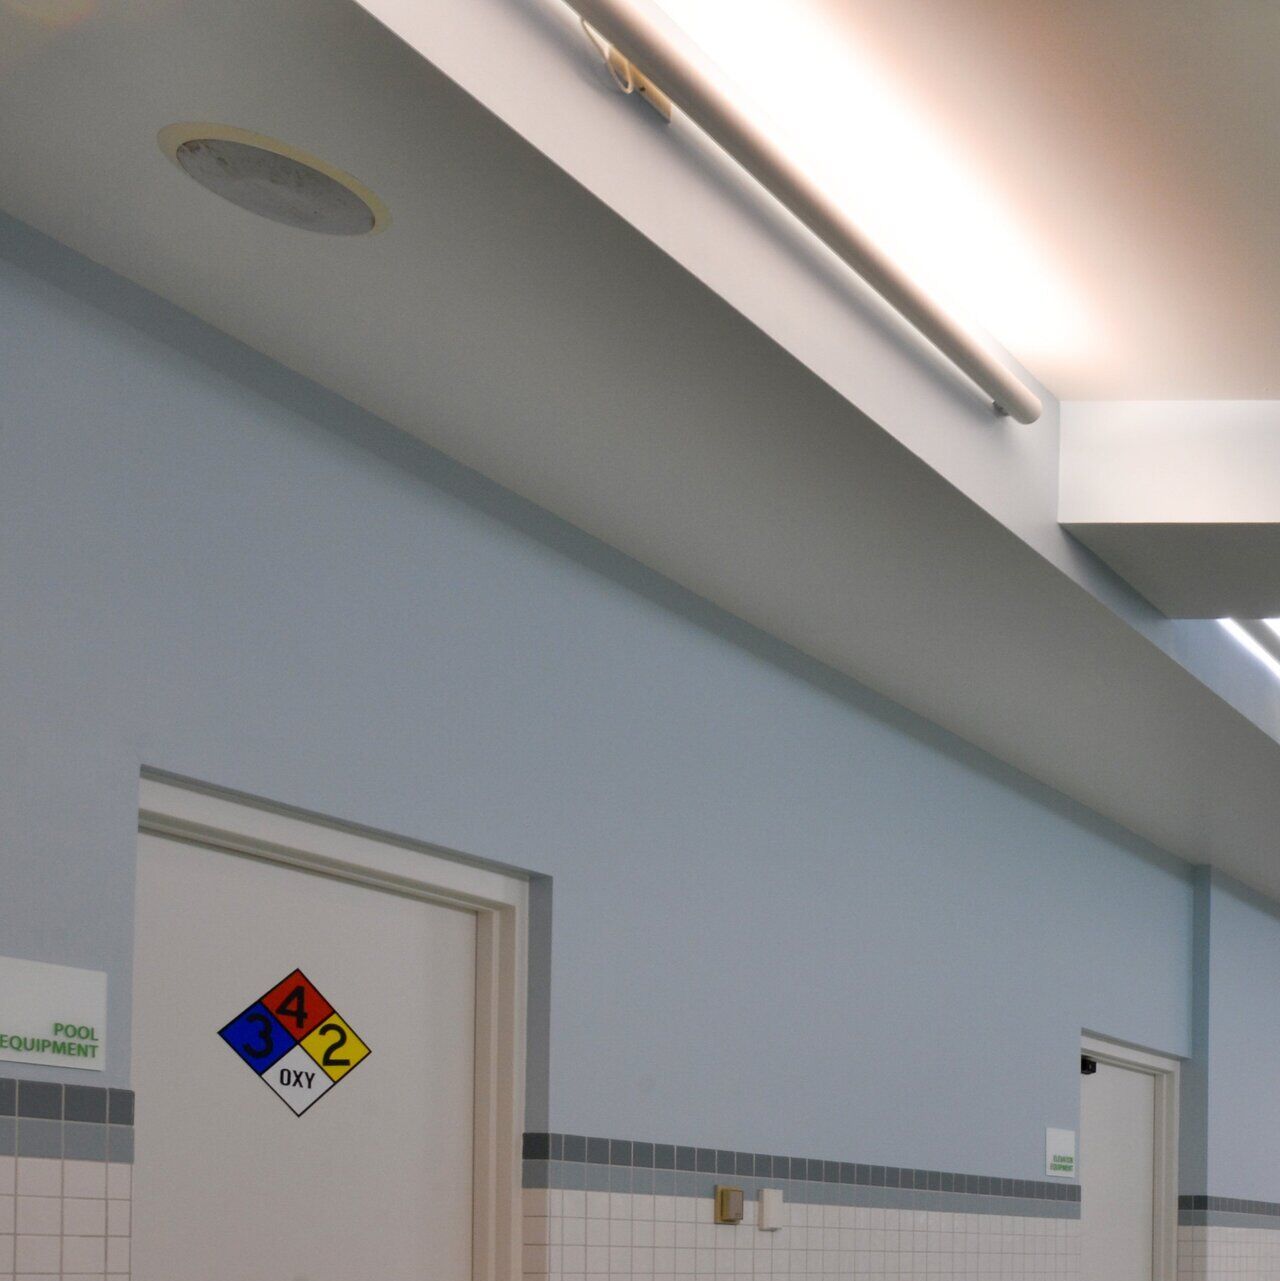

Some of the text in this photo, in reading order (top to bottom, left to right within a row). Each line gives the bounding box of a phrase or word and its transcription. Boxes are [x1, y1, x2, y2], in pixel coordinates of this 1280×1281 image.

[275, 985, 308, 1029] 4
[0, 1034, 99, 1058] EQUIPMENT
[53, 1022, 99, 1041] POOL
[242, 1013, 274, 1060] 3
[318, 1023, 351, 1067] 2
[279, 1068, 316, 1089] OXY
